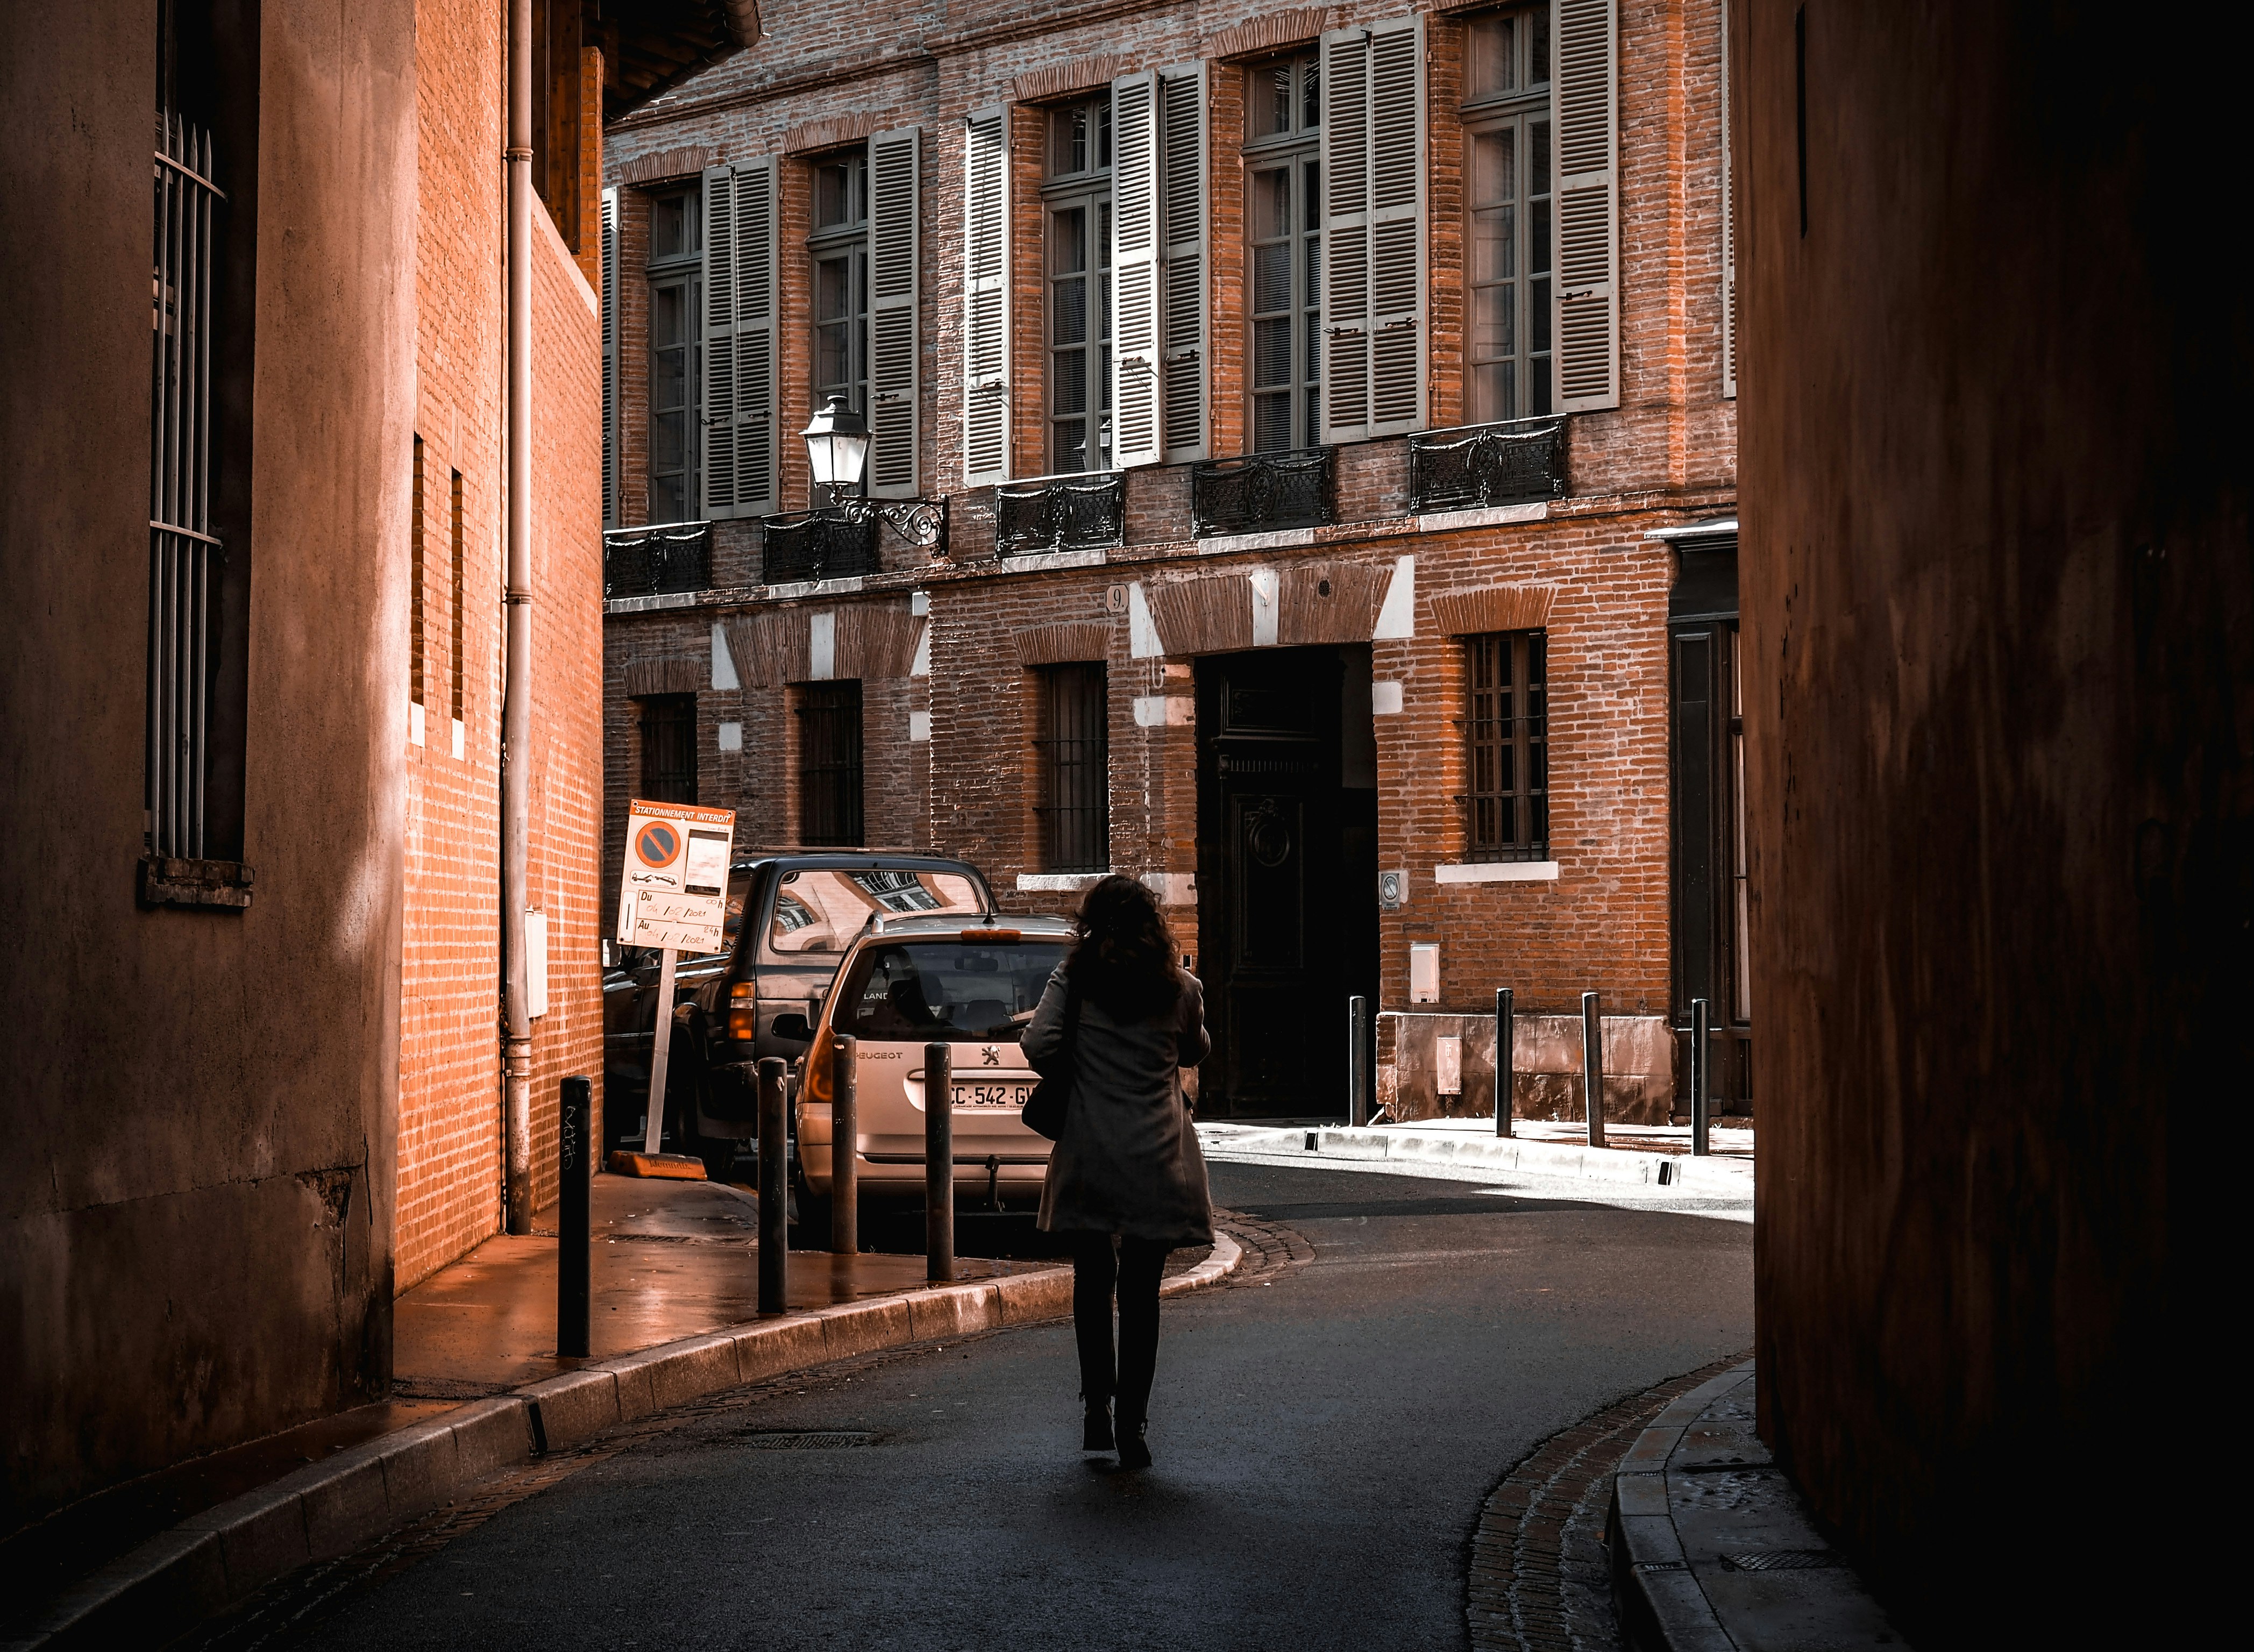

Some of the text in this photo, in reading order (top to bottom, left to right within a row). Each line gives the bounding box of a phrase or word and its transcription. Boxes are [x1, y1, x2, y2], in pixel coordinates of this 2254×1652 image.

[635, 806, 731, 823] STATIONNEMENT INTERDIT
[641, 892, 652, 901] Du
[638, 920, 650, 930] Au
